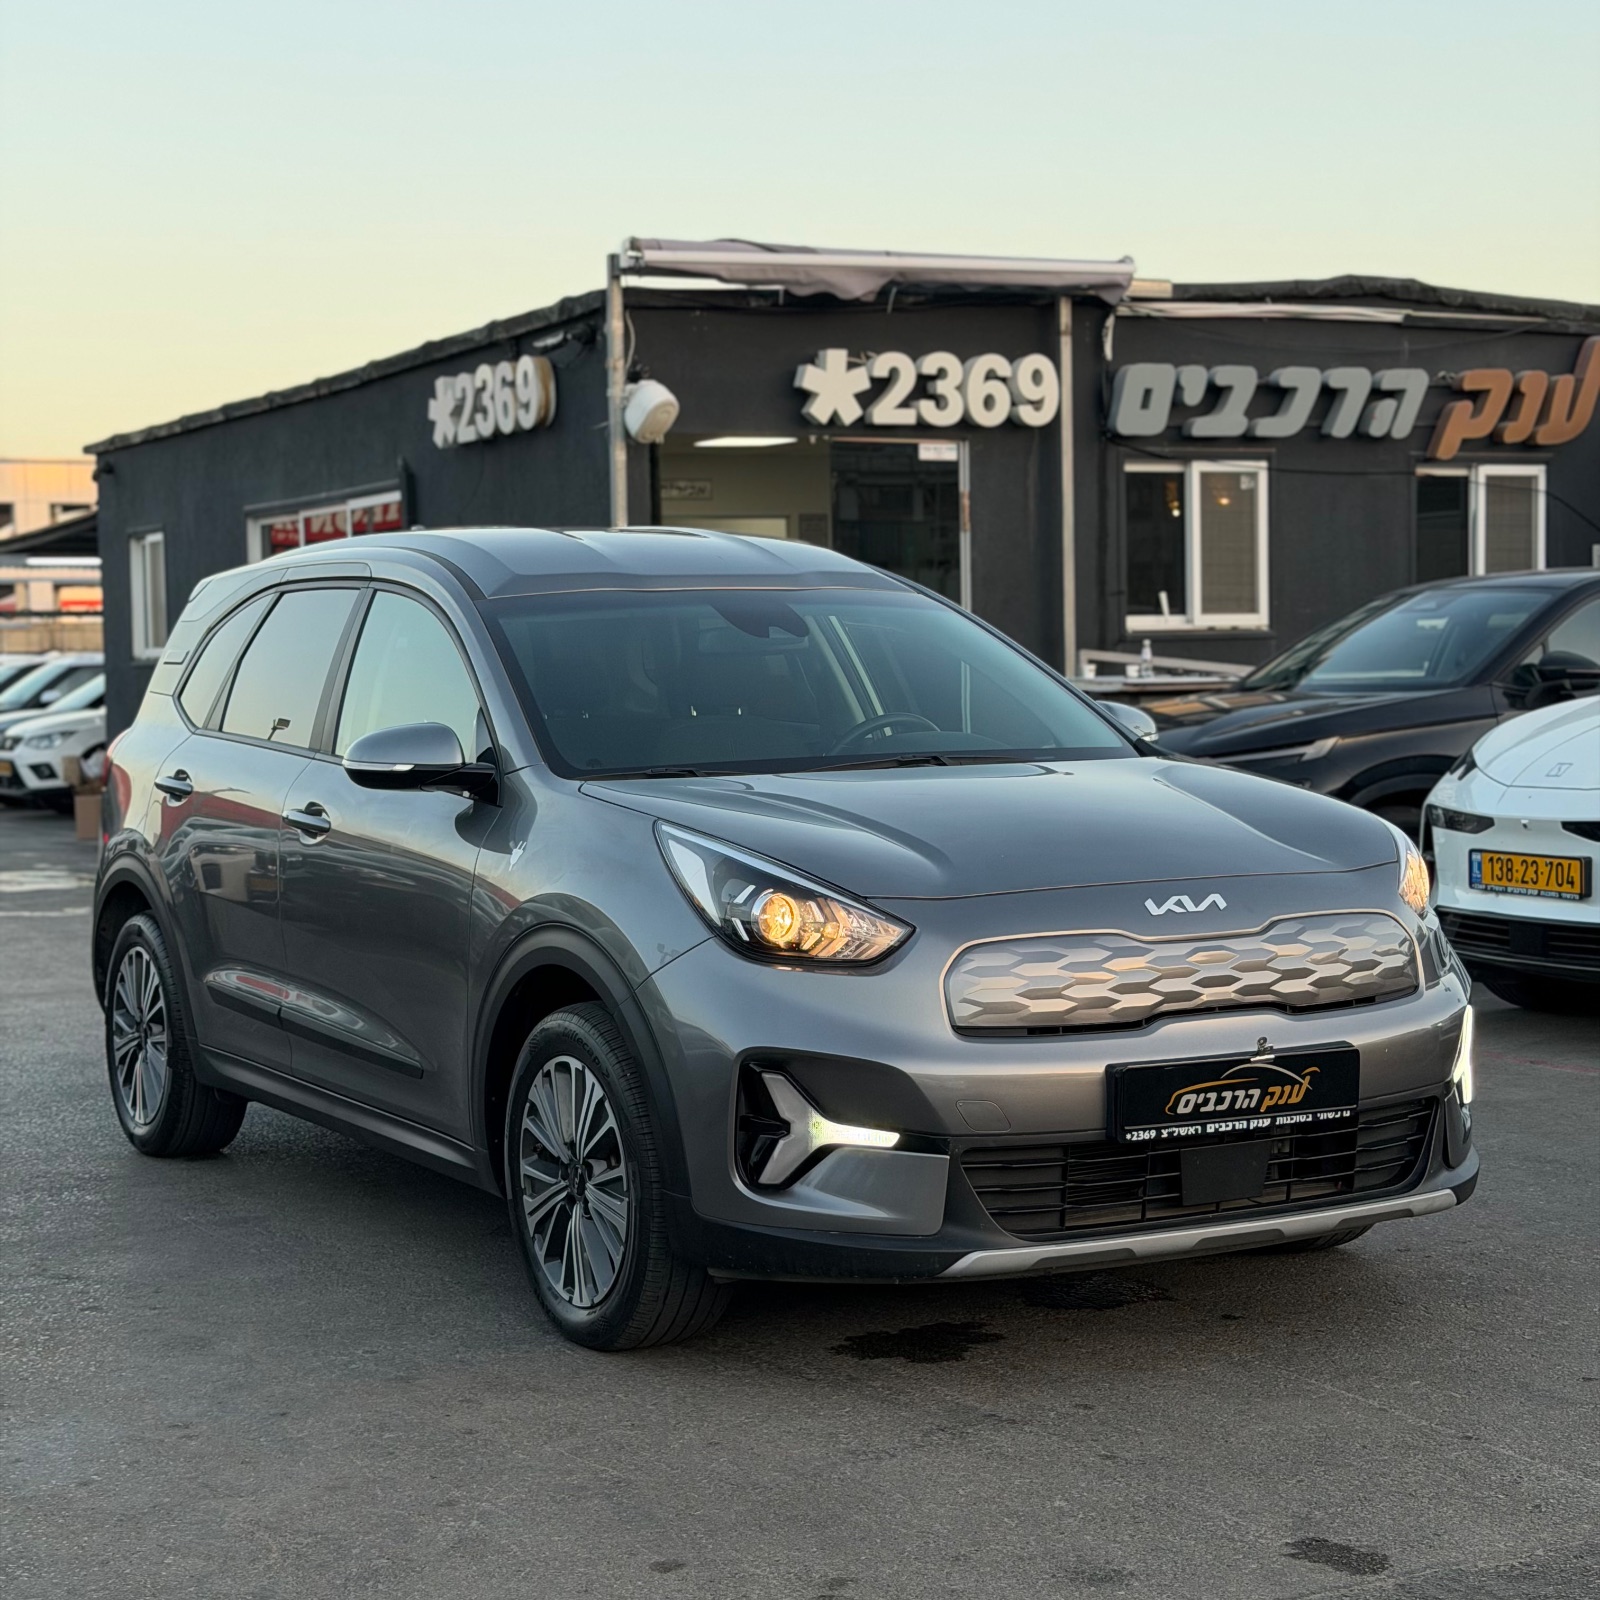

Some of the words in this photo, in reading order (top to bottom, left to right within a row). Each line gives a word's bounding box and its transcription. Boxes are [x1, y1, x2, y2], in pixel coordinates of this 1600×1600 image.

[1112, 362, 1430, 439] הרכבים
[1426, 335, 1600, 461] ענק
[1144, 893, 1228, 916] KIA
[1176, 1088, 1261, 1114] הרכבים
[1260, 1075, 1311, 1113] ענק
[1206, 1120, 1248, 1133] הרכבים
[1250, 1118, 1271, 1130] ענק
[1276, 1113, 1313, 1125] בסוכנות
